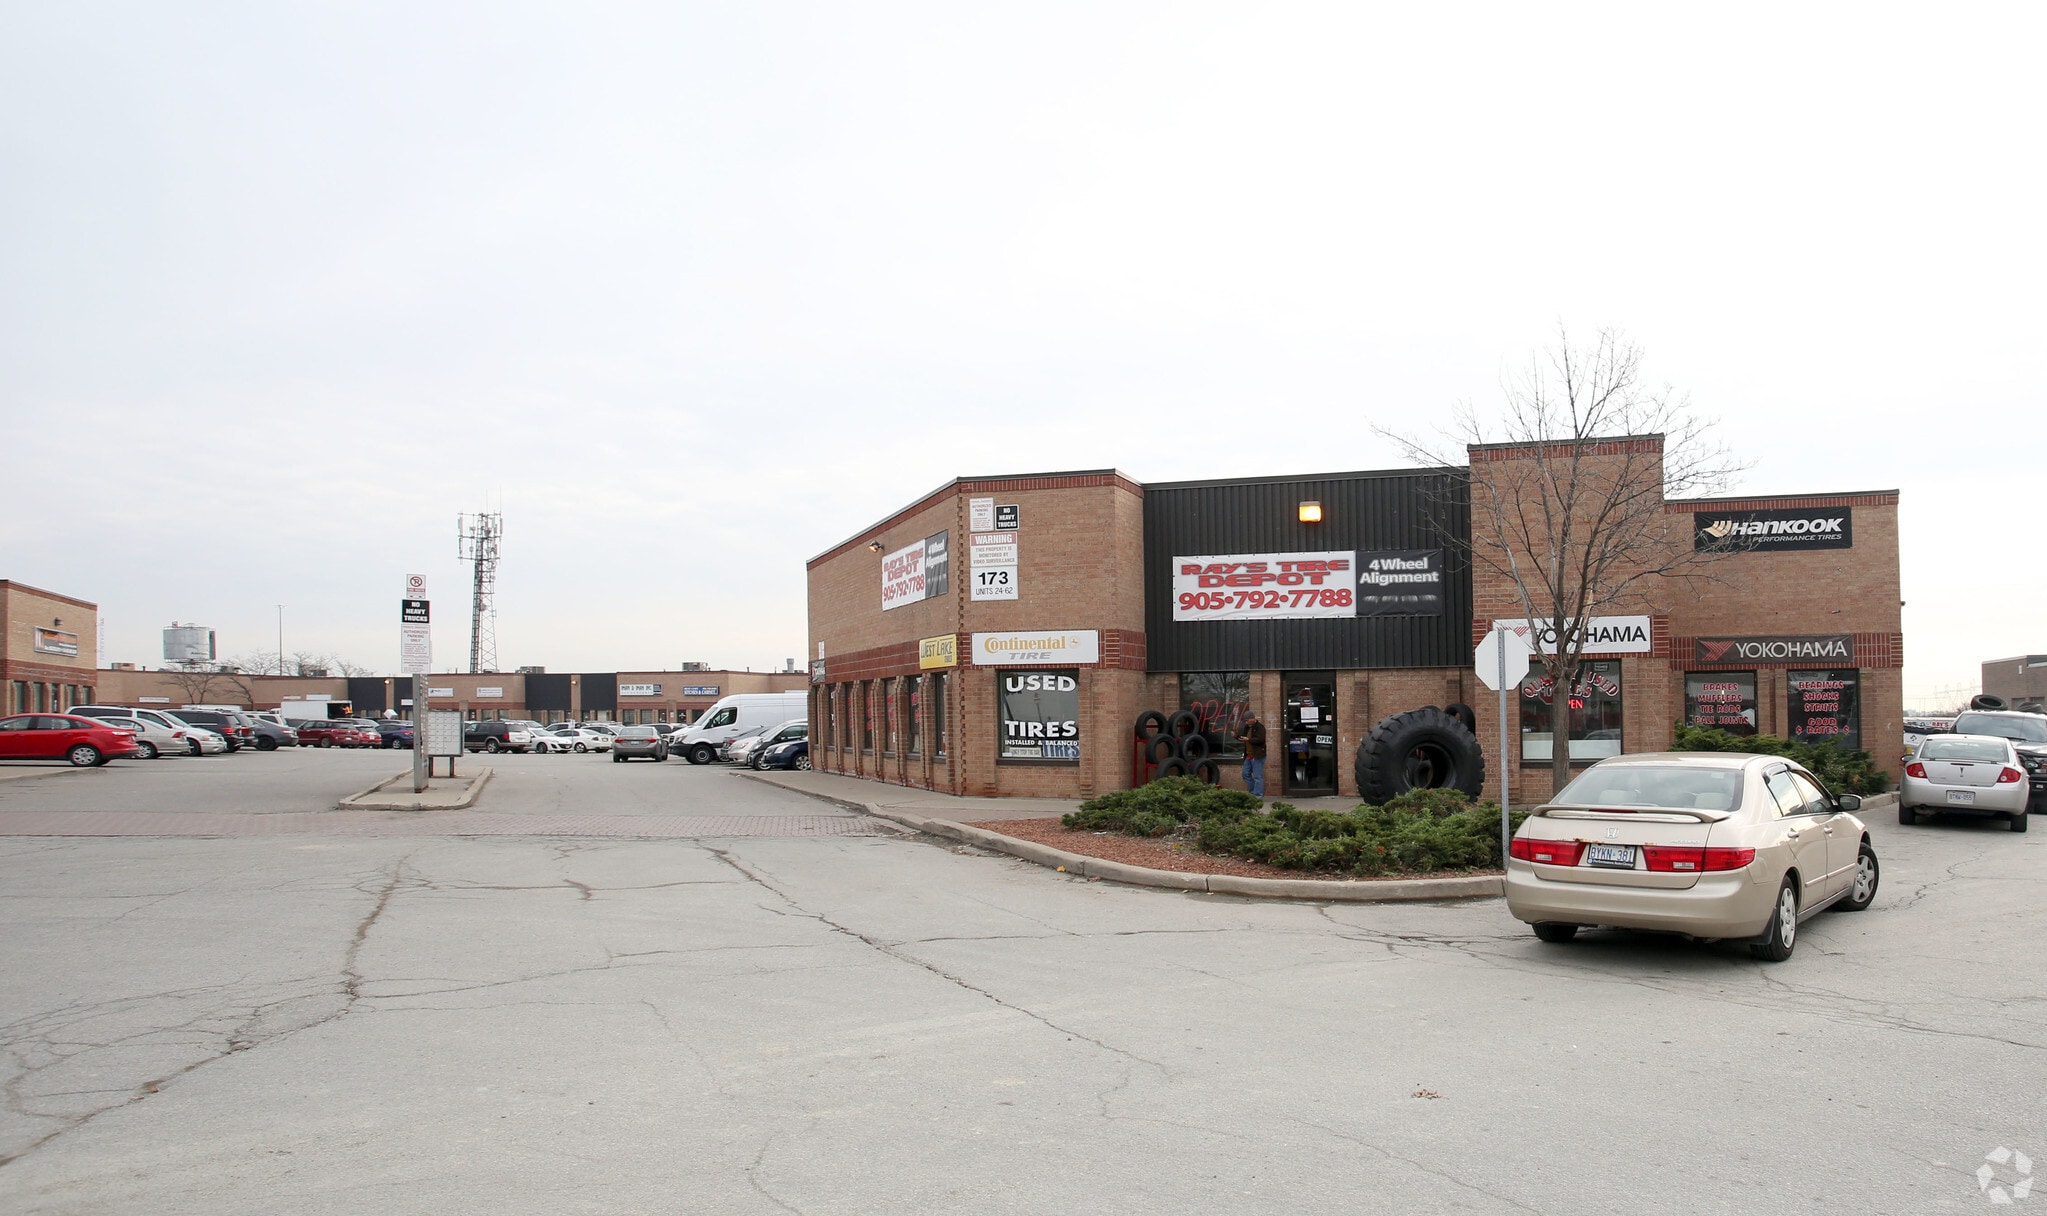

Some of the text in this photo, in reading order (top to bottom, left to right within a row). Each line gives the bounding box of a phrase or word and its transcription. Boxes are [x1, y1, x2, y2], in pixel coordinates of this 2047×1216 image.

[975, 534, 1012, 544] WARNING
[1752, 535, 1815, 543] PERFORMANCE
[1181, 560, 1349, 575] RAY'S TIRE
[1369, 558, 1428, 570] 4 Wheel
[888, 560, 918, 581] DEPOT
[978, 572, 1008, 585] 173
[1198, 572, 1330, 587] DEPOT
[1360, 572, 1439, 585] Alignment
[1536, 626, 1647, 644] YOHAMA
[937, 641, 953, 656] LAKE
[984, 636, 1065, 654] Continental
[1735, 641, 1847, 658] YOKOHAMA
[1009, 652, 1052, 660] TIRE
[1006, 675, 1076, 692] USED
[1703, 683, 1738, 691] BRAKES
[1799, 680, 1844, 689] BEARINGS
[1698, 694, 1742, 702] MUFFLERS
[1803, 691, 1839, 700] SHOCKS
[1700, 704, 1741, 713] TIE RODS
[1804, 703, 1839, 712] STRUTS
[1191, 700, 1249, 733] OPEN
[1695, 716, 1748, 725] BALL JOINTS
[1808, 717, 1836, 726] GOOD
[1004, 720, 1077, 737] TIRES
[1807, 725, 1838, 734] RATES
[1590, 847, 1612, 860] BYKN
